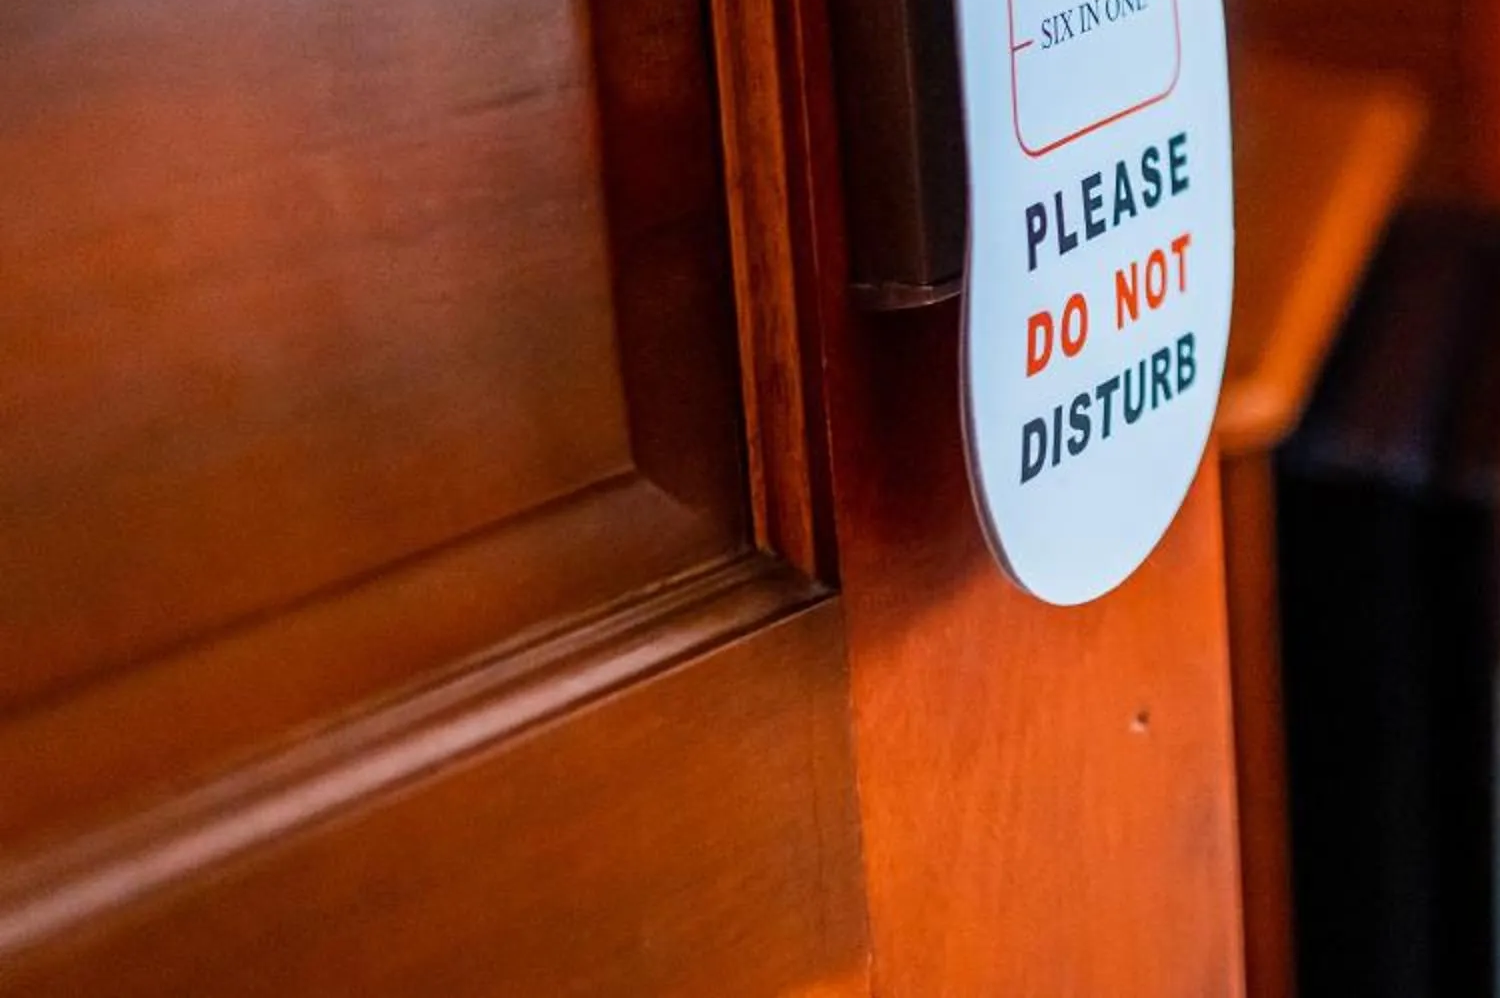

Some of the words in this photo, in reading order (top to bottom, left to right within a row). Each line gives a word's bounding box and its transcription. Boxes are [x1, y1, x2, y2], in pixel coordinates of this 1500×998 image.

[1041, 8, 1075, 50] SIX
[1025, 132, 1191, 272] PLEASE
[1026, 293, 1090, 378] DO
[1114, 233, 1192, 330] NOT
[1020, 332, 1198, 485] DISTURB
